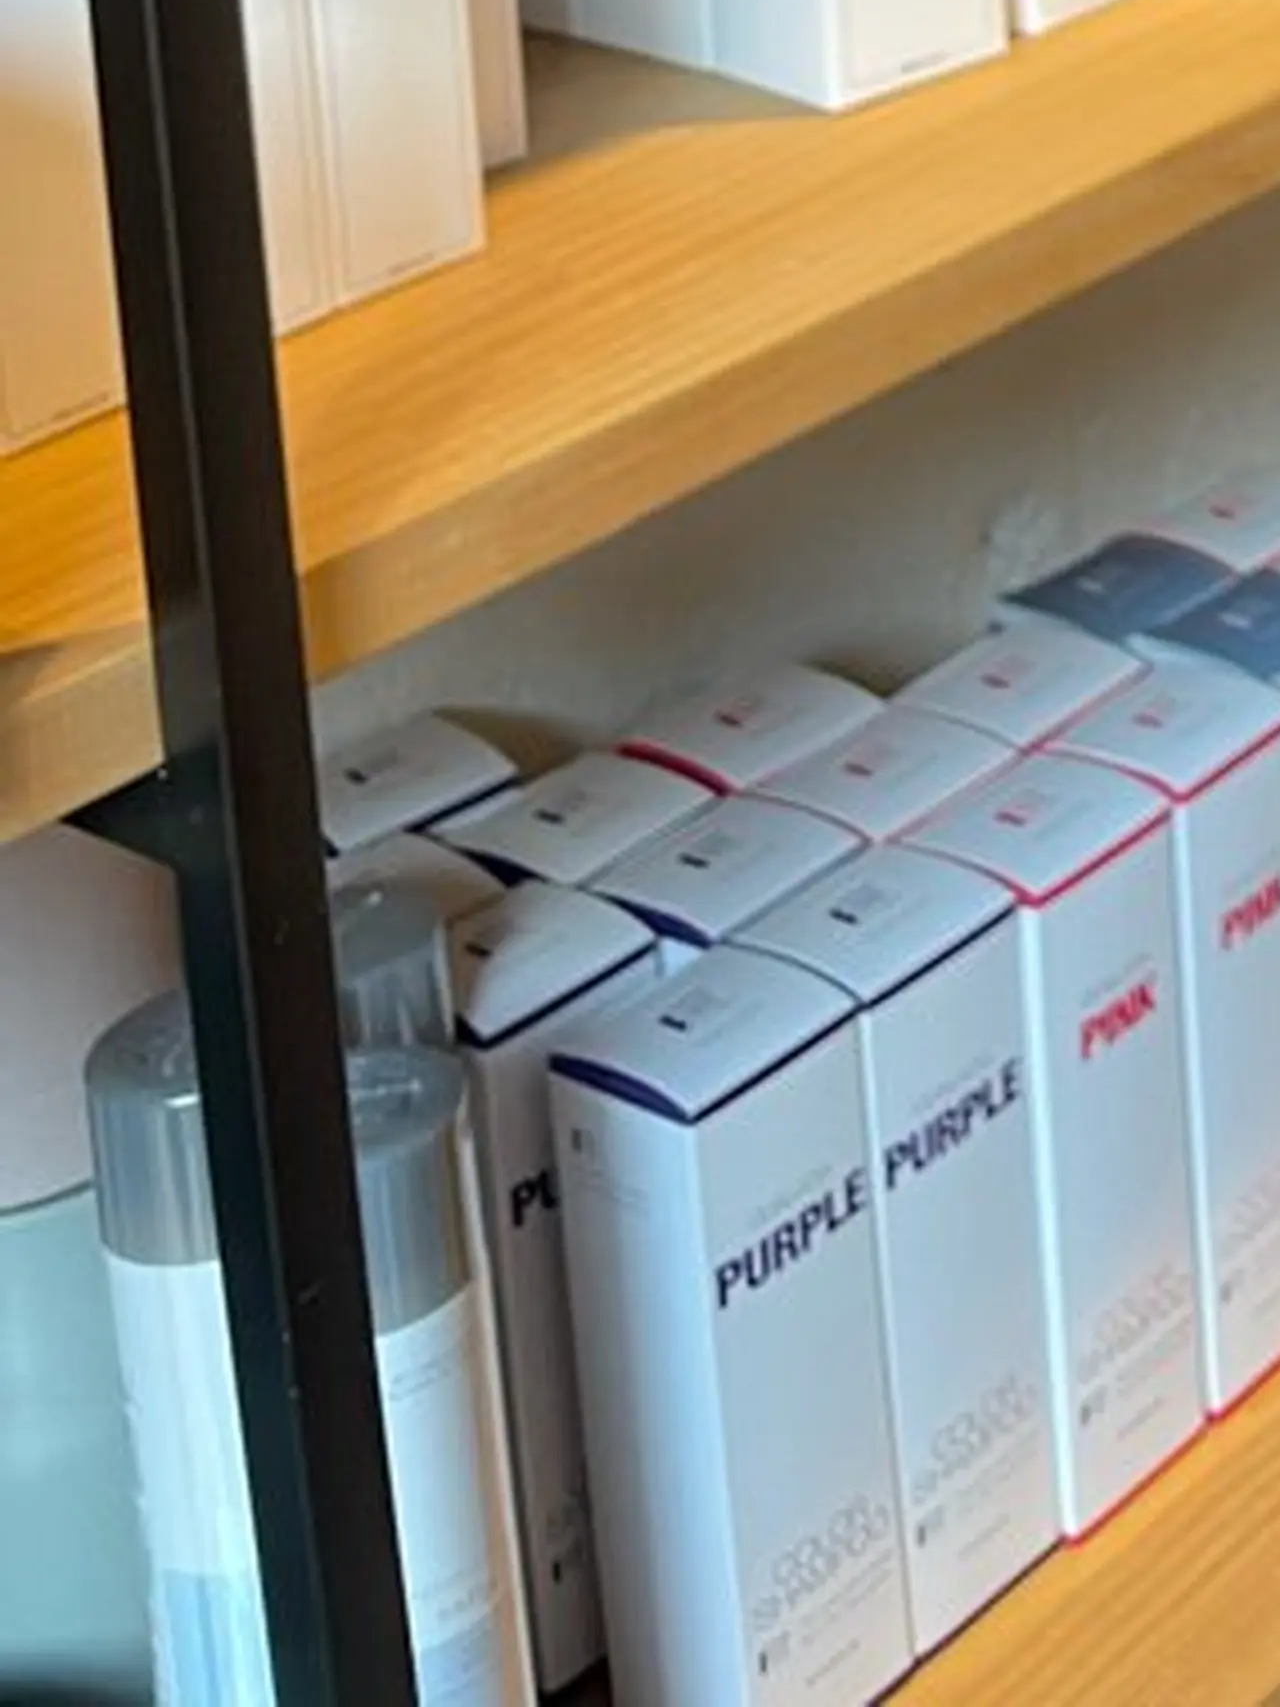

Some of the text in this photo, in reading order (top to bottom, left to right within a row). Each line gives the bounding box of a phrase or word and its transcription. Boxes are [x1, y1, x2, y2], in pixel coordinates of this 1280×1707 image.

[1080, 971, 1156, 1060] PINK
[885, 1056, 1022, 1191] PURPLE
[511, 1170, 559, 1228] PU
[715, 1166, 868, 1310] PURPLE
